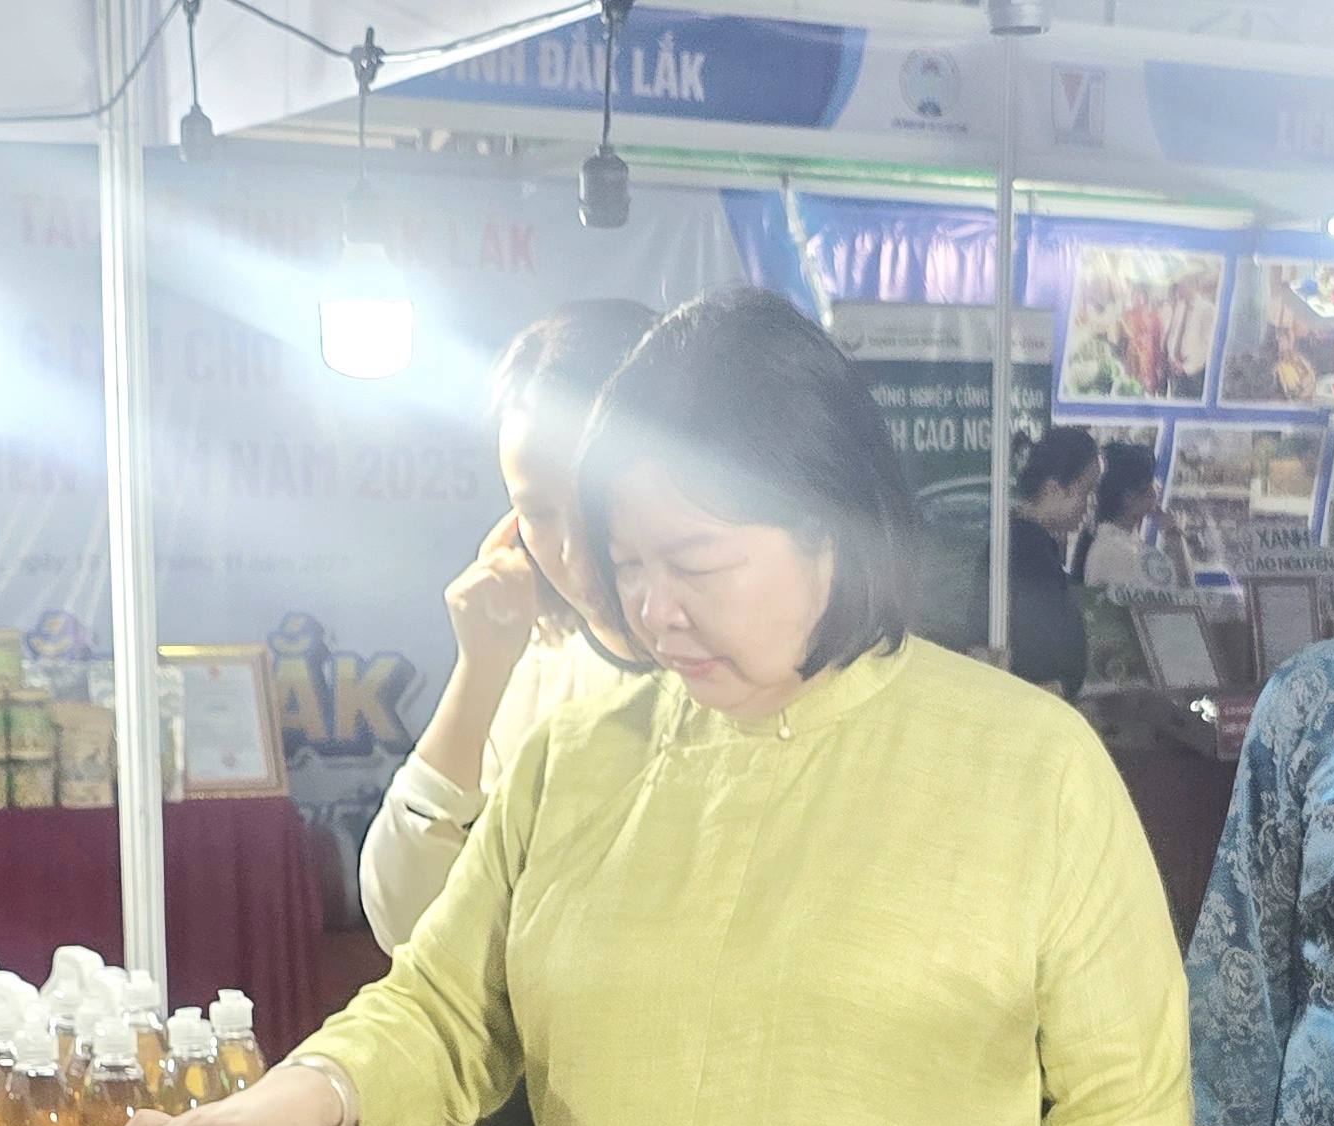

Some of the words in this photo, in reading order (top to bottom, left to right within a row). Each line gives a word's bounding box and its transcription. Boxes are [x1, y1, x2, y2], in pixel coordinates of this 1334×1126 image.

[631, 31, 706, 103] LẮK
[913, 417, 957, 452] CAO
[355, 446, 480, 502] 2025
